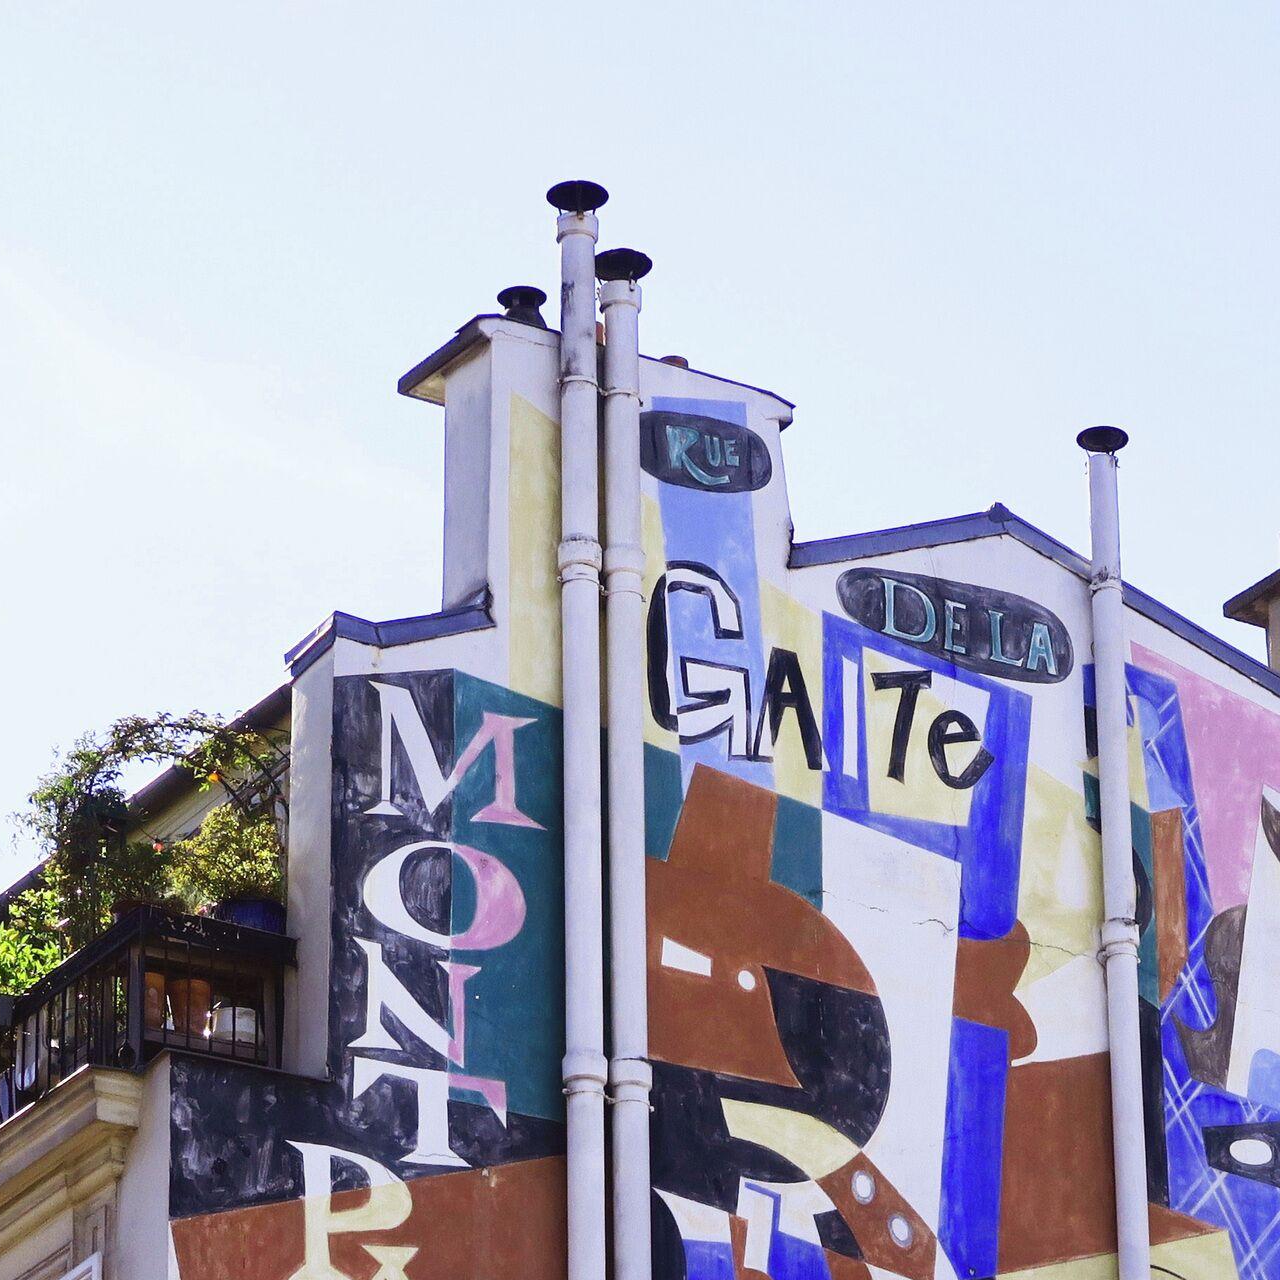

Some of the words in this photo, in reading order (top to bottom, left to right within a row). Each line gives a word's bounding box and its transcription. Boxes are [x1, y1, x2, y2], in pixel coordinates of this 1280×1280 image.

[665, 424, 742, 486] RUE
[880, 575, 967, 655] DE
[987, 608, 1059, 677] LA
